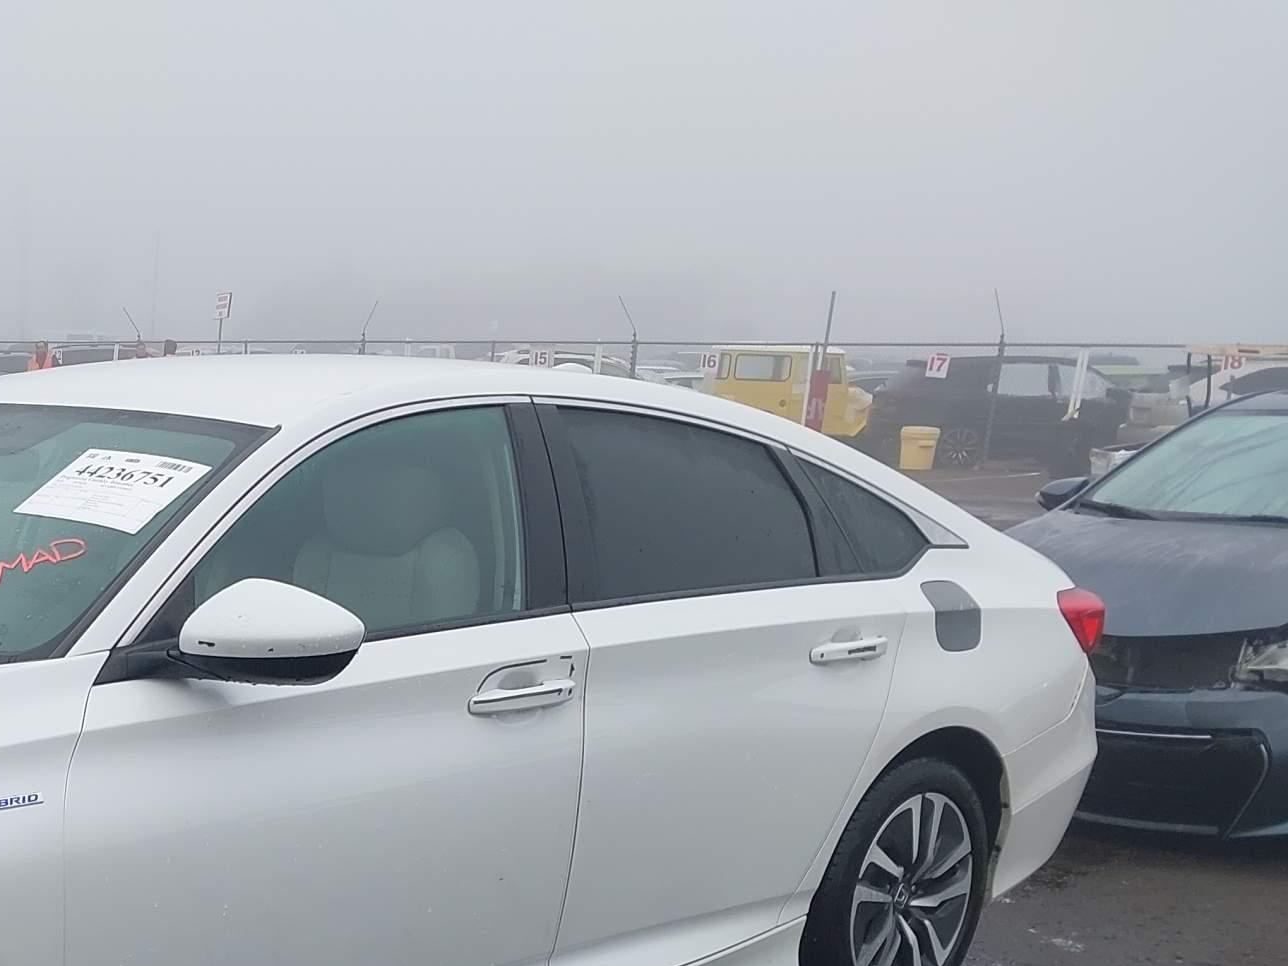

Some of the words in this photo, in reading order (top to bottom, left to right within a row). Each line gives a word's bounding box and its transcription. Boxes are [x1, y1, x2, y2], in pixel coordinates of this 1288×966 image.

[534, 351, 548, 366] 15
[702, 354, 717, 368] 16
[928, 355, 949, 372] 17
[74, 464, 175, 488] 44236751
